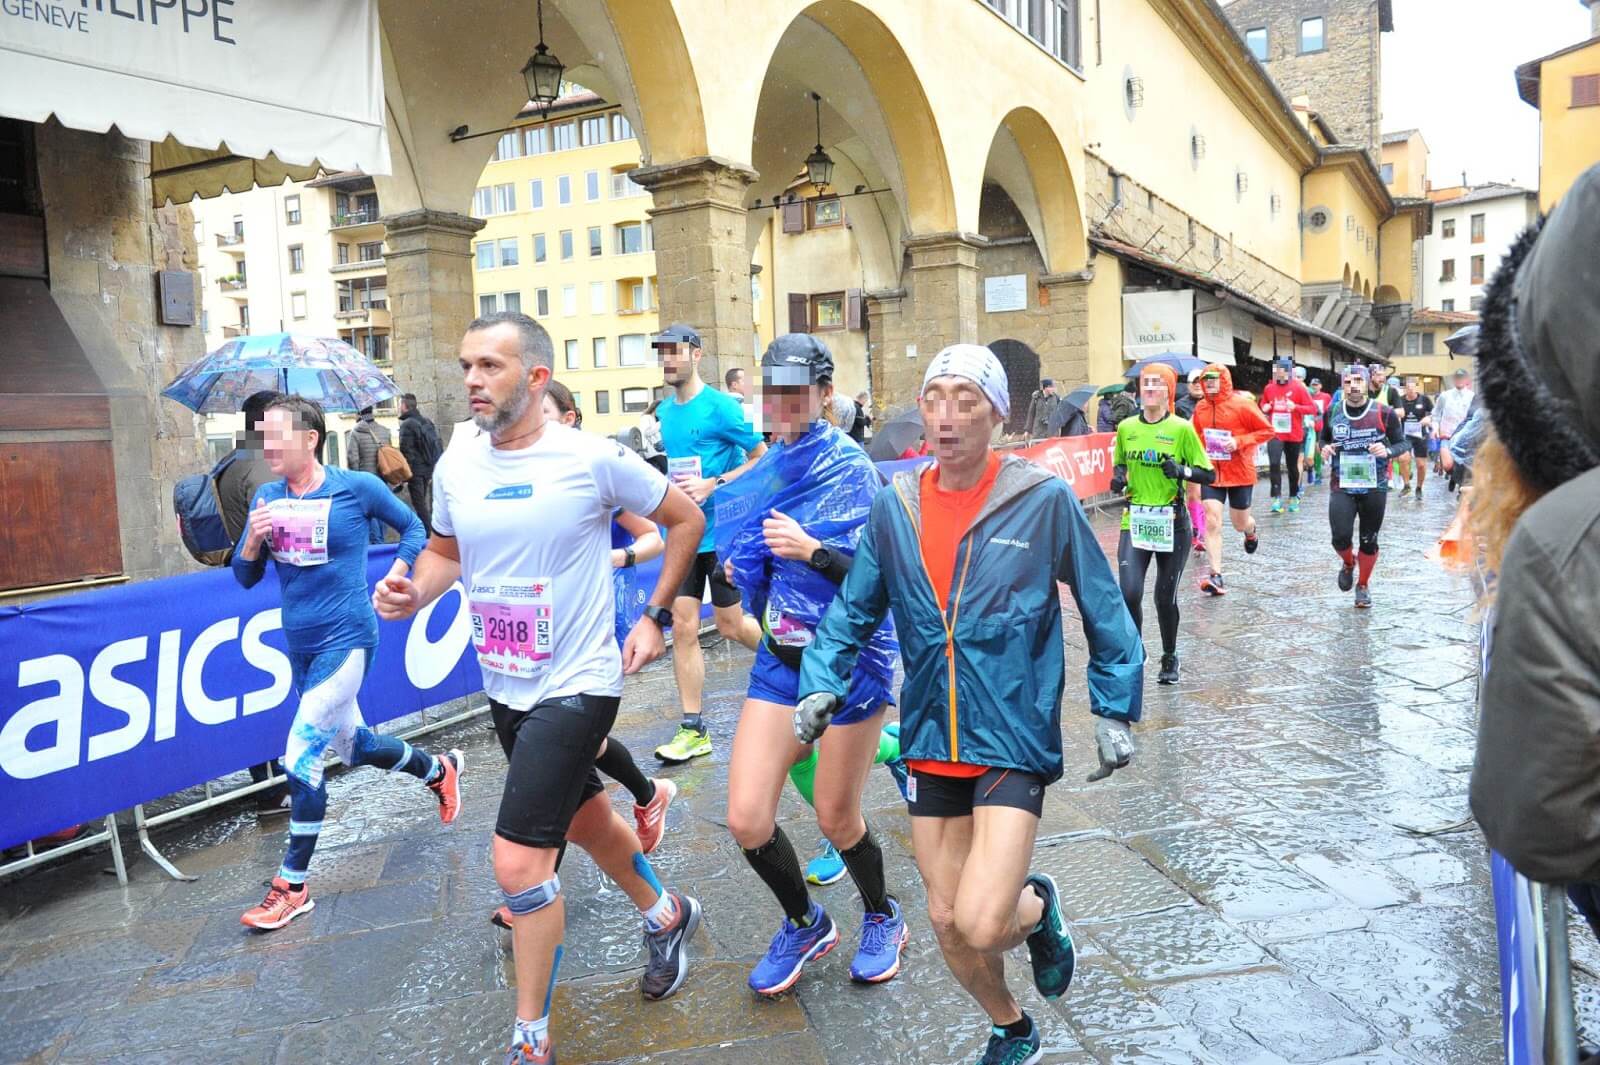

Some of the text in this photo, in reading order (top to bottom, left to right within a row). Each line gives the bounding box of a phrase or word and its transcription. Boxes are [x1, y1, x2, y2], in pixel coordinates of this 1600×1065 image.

[2, 0, 89, 33] GENEVE
[1138, 333, 1176, 343] ROLEX
[1138, 524, 1165, 537] F1296
[488, 617, 528, 643] 2918
[0, 607, 293, 780] asics
